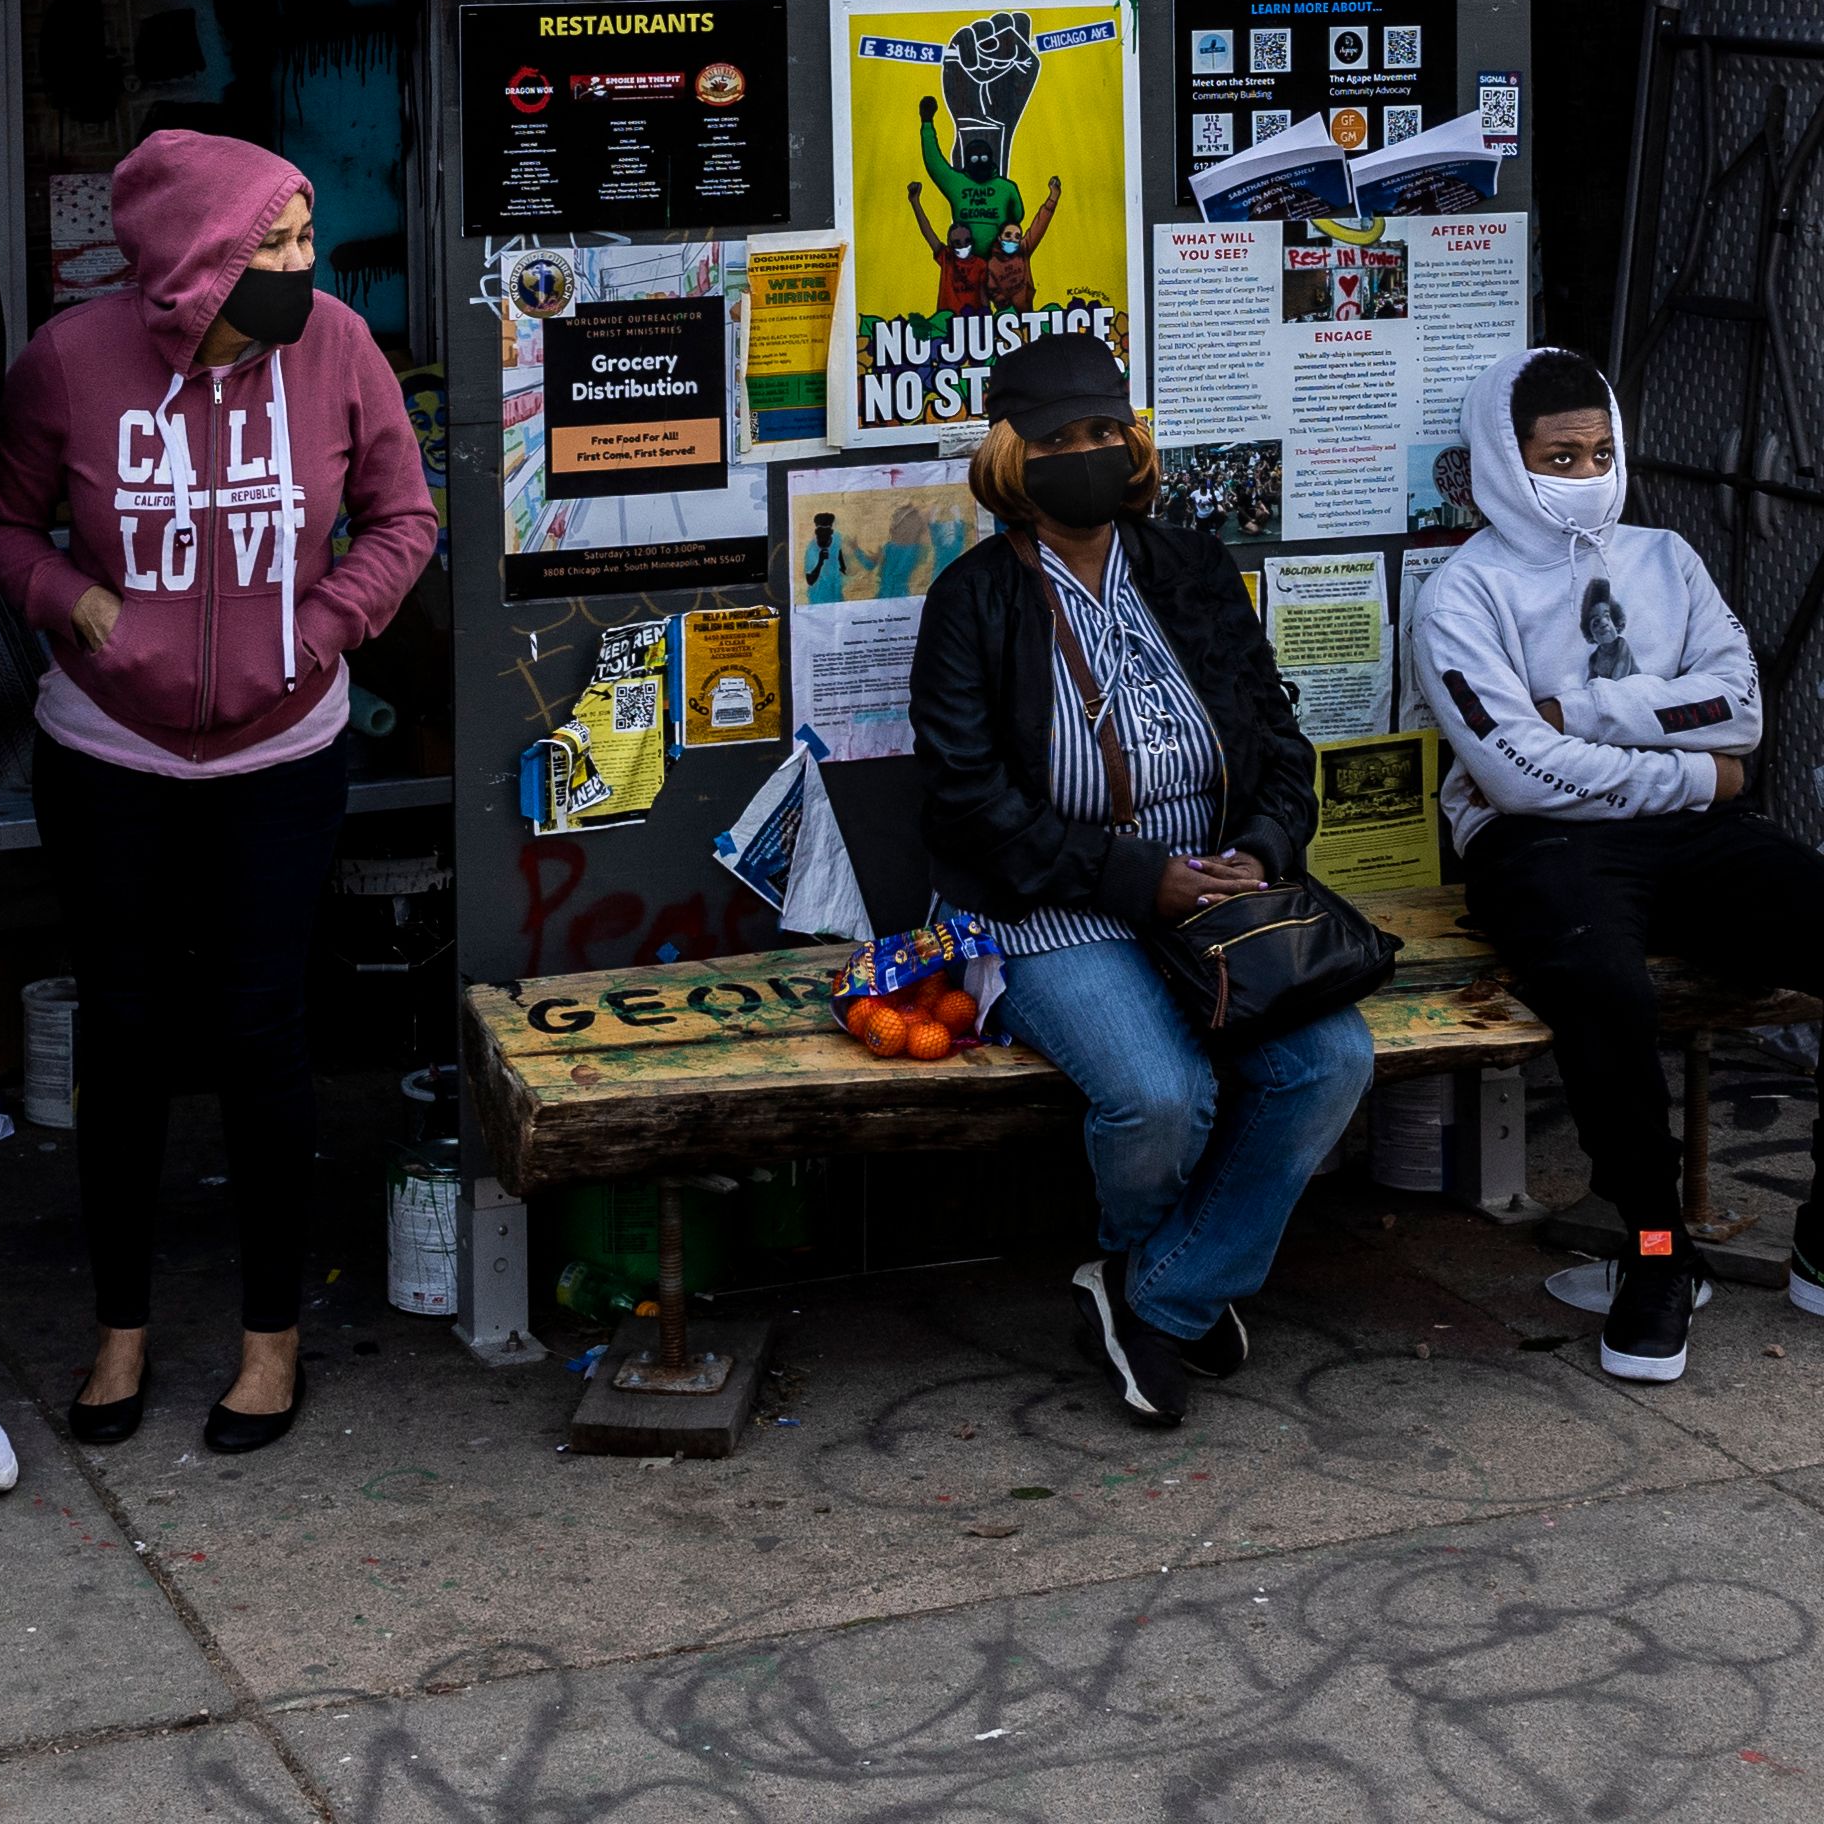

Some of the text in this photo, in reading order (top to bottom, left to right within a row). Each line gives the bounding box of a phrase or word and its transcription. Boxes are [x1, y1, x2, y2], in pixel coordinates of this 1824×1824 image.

[1251, 2, 1382, 15] LEARN MORE ABOUT...
[540, 13, 714, 37] RESTAURANTS
[1043, 26, 1109, 49] CHICAGO AVE
[864, 41, 934, 60] E 38th St
[649, 76, 666, 84] THE
[668, 75, 680, 83] PIT
[1192, 79, 1214, 87] Meet
[1229, 78, 1243, 86] the
[1245, 77, 1275, 86] Streets
[1347, 75, 1371, 85] Agape
[1374, 72, 1416, 81] Movement
[1480, 75, 1506, 84] SIGNAL
[961, 188, 995, 198] STAND
[970, 197, 987, 206] FOR
[960, 208, 999, 219] GEORGE
[1431, 224, 1507, 237] AFTER YOU
[1173, 232, 1255, 245] WHAT WILL
[1448, 240, 1491, 251] LEAVE
[1179, 248, 1248, 260] YOU SEE?
[1288, 248, 1401, 267] Rest IN Power
[766, 292, 830, 304] HIRING
[1315, 330, 1372, 342] ENGAGE
[876, 320, 931, 366] NO
[591, 354, 678, 373] Grocery
[572, 377, 698, 401] Distribution
[865, 371, 923, 422] NO
[591, 432, 678, 445] Free Food For All!
[577, 446, 695, 462] First Come, First Served!
[231, 487, 277, 503] REPUBLIC
[1280, 562, 1375, 576] ABOLITION IS A PRACTICE
